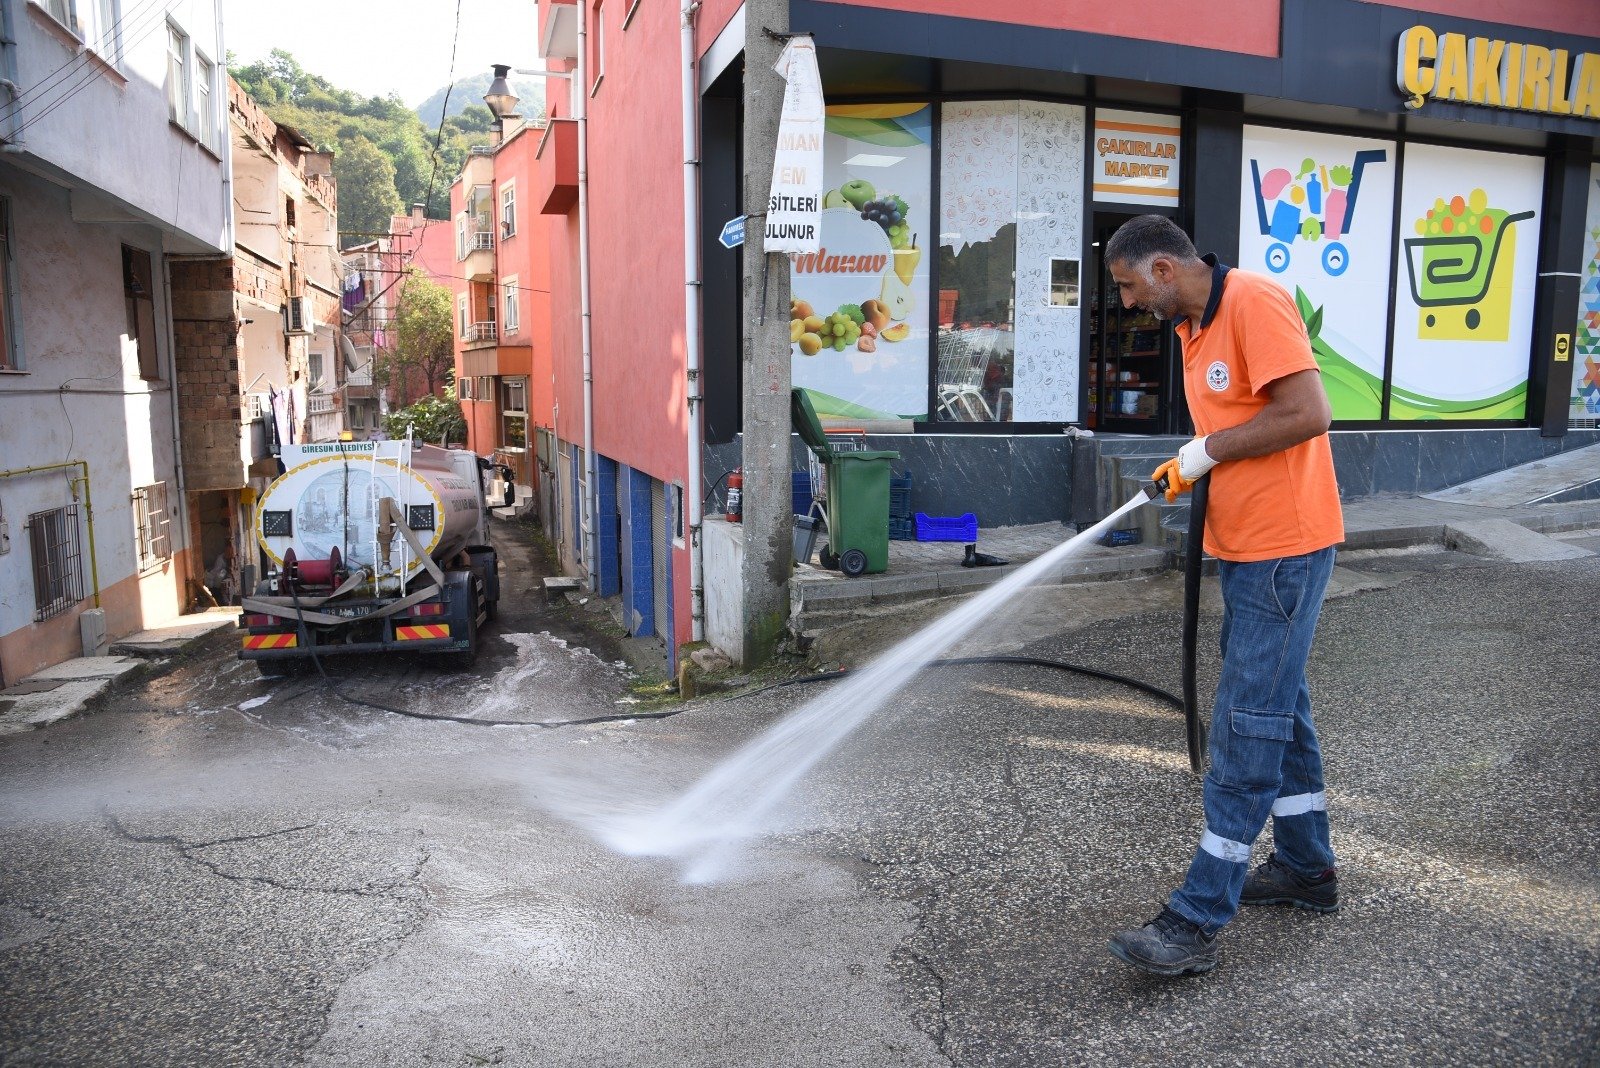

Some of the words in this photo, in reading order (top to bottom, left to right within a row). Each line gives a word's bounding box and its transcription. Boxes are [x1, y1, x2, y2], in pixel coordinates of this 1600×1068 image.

[1096, 137, 1177, 160] ÇAKIRLAR
[1104, 160, 1170, 178] MARKET
[790, 247, 887, 273] Manav
[356, 606, 369, 615] 170
